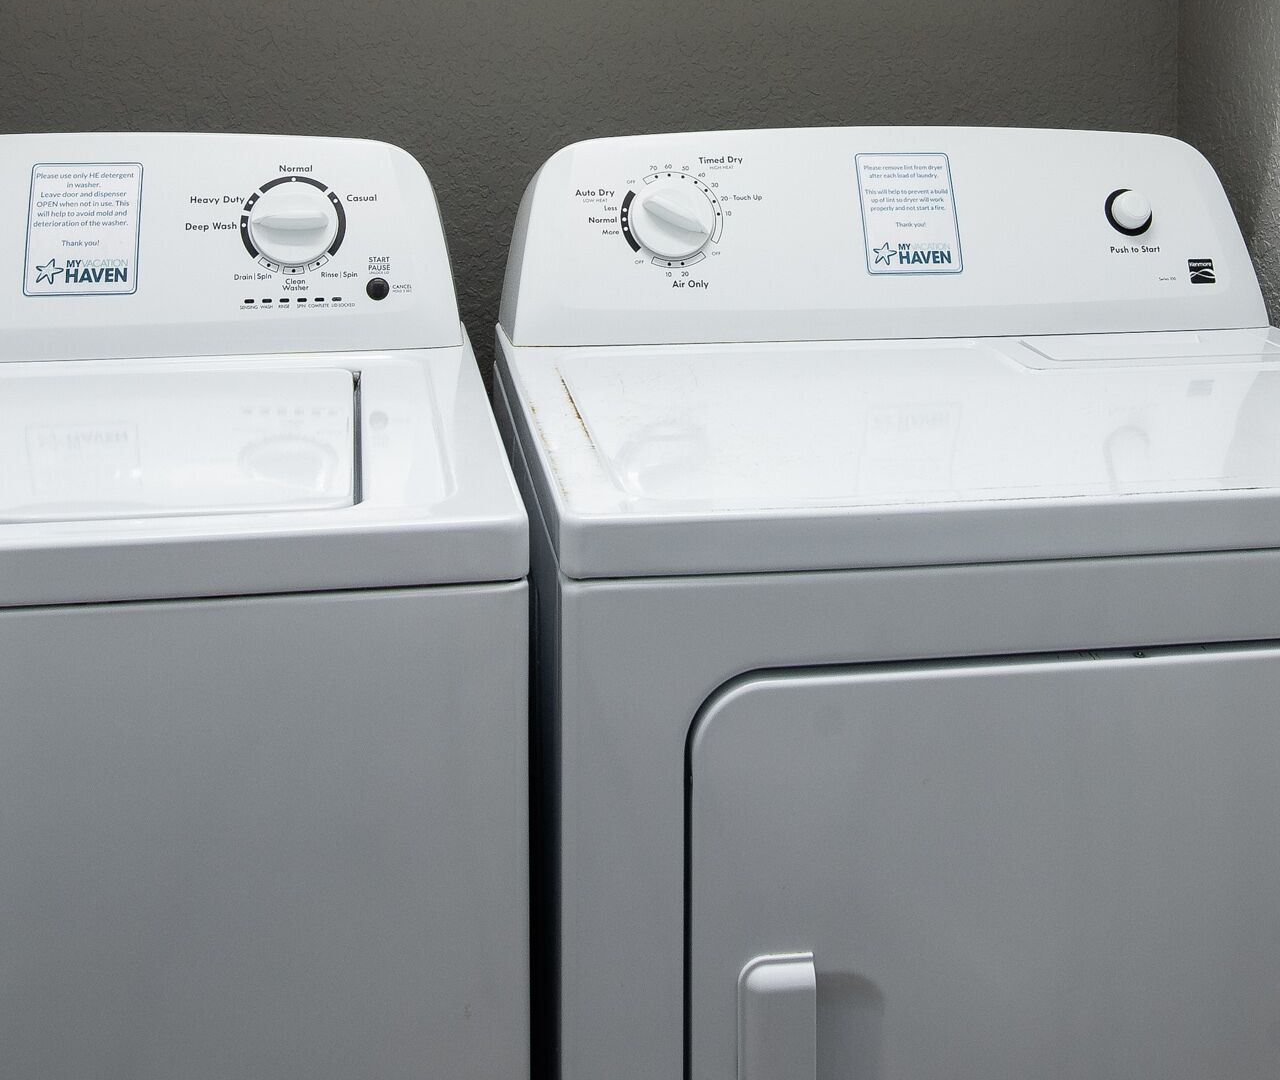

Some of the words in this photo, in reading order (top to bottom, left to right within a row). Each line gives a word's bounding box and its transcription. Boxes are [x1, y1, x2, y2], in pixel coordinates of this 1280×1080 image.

[698, 156, 724, 165] Timed
[727, 156, 743, 165] Dry
[279, 165, 313, 173] Normal
[73, 172, 87, 180] only
[100, 172, 134, 180] detergent
[94, 191, 127, 199] dispenser
[575, 189, 596, 197] Auto
[598, 189, 615, 197] Dry
[190, 196, 220, 205] Heavy
[223, 195, 245, 204] Duty
[346, 194, 377, 202] Casual
[752, 194, 763, 202] Up
[33, 220, 80, 228] deterioration
[588, 216, 618, 224] Normal
[185, 222, 209, 232] Deep
[212, 222, 237, 230] Wash
[62, 239, 83, 247] Thank
[84, 239, 100, 248] you!
[1110, 246, 1129, 254] Push
[898, 251, 951, 264] HAVEN
[65, 268, 128, 283] HAVEN
[672, 280, 686, 288] Air
[688, 279, 709, 289] Only
